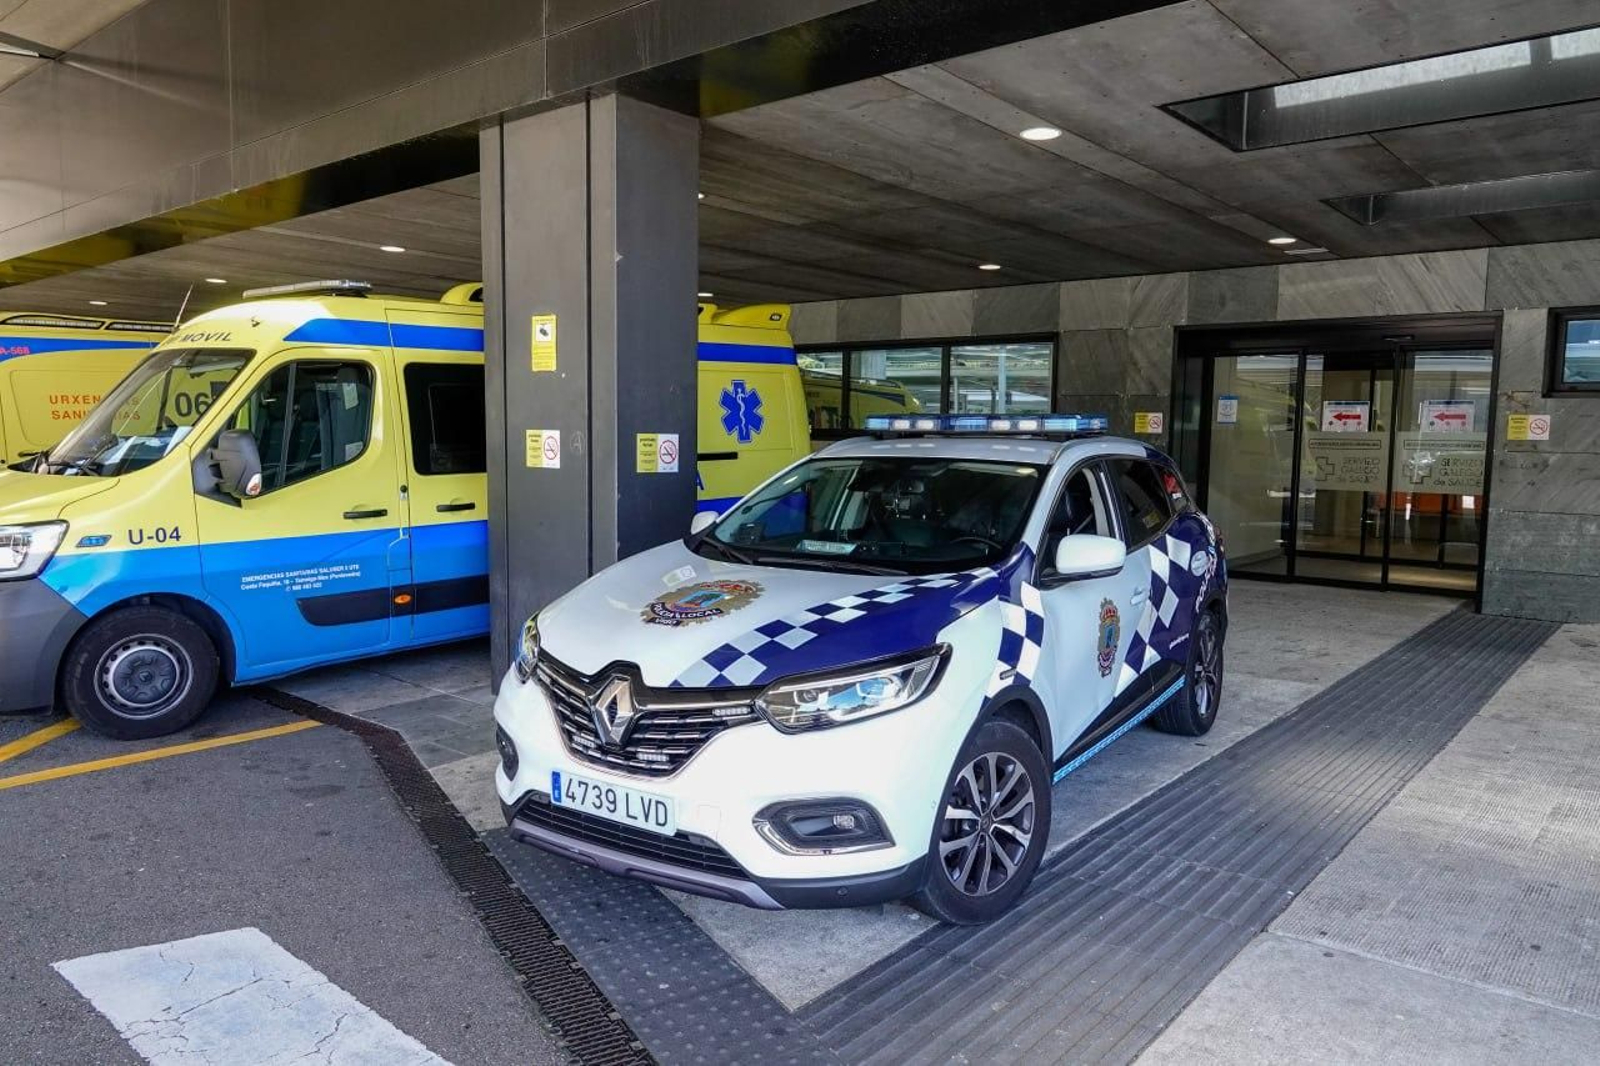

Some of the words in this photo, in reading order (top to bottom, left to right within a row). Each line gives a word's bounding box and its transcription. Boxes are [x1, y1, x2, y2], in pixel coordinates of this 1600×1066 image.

[128, 526, 182, 545] U-04
[565, 778, 617, 813] 4739
[626, 792, 668, 827] LVD
